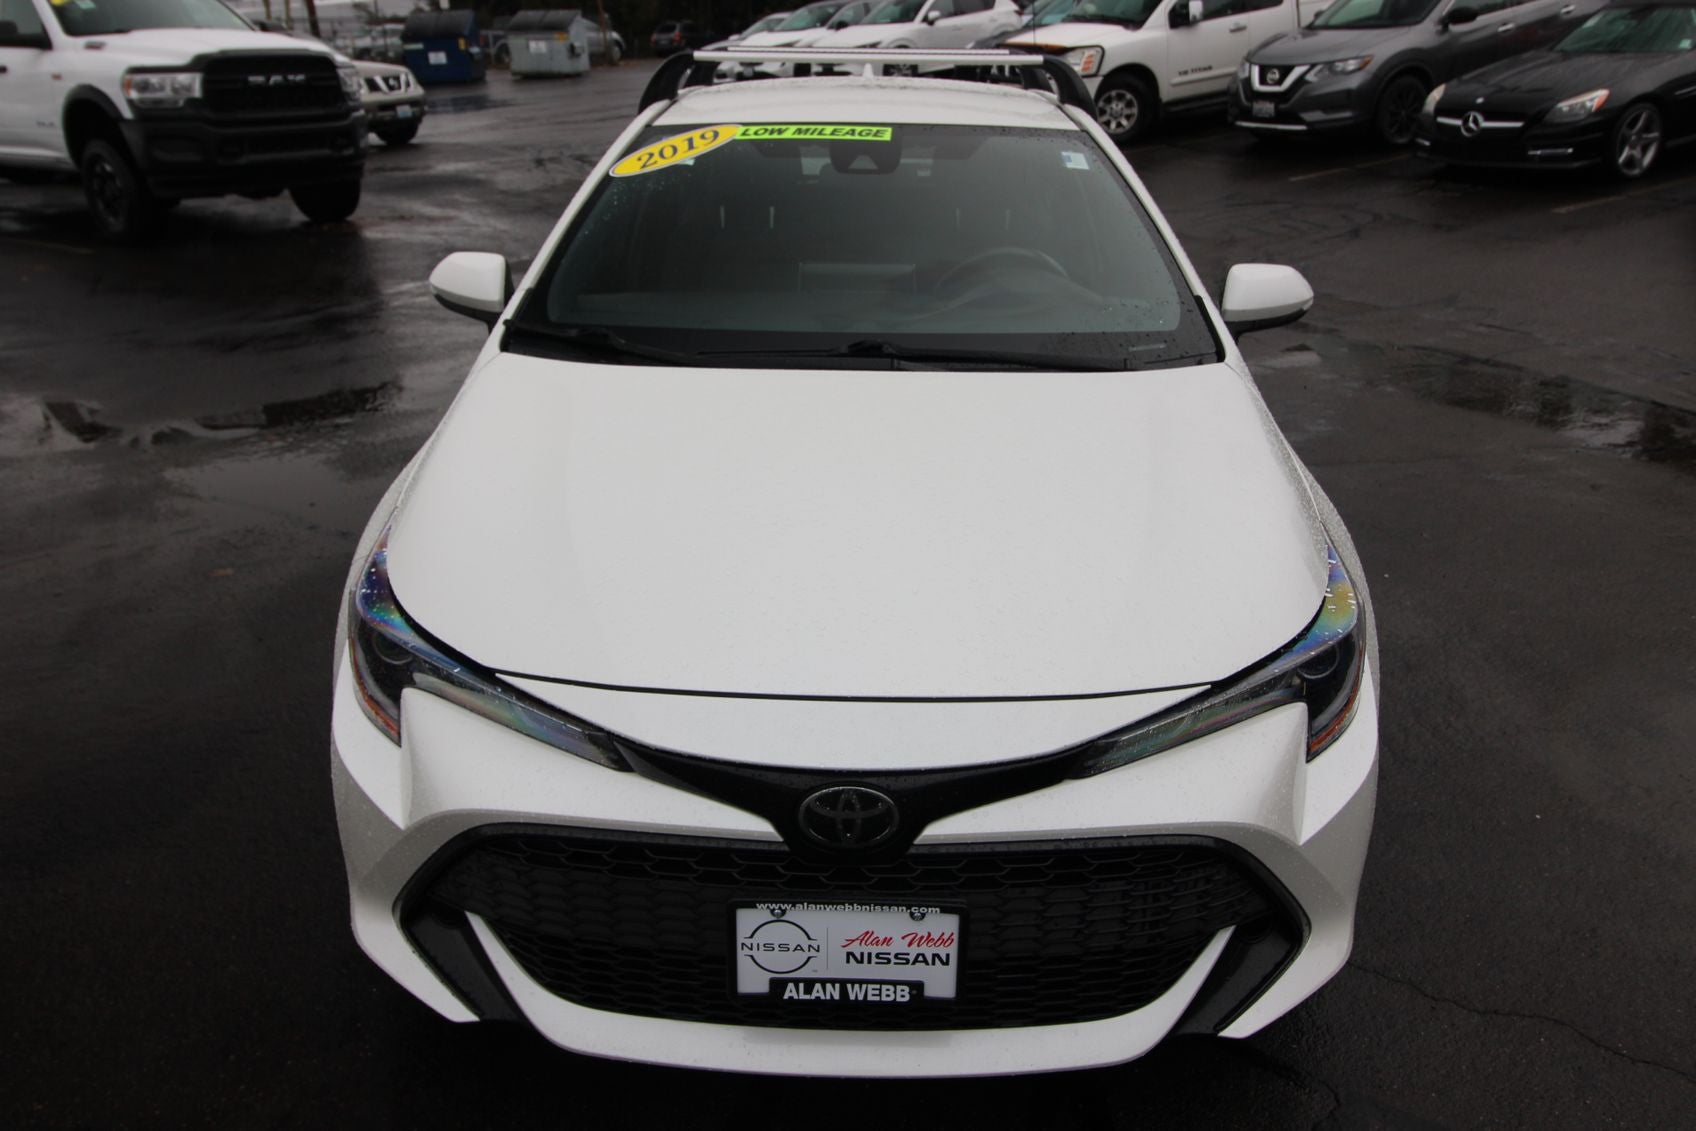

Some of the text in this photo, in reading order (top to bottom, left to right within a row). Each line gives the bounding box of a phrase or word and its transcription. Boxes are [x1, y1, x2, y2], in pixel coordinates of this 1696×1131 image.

[740, 127, 888, 138] LOW MILEAGE
[637, 129, 720, 169] 2019
[756, 902, 941, 914] www.alanwebbnissan.com
[840, 930, 955, 949] Alan Webb
[740, 942, 820, 953] NISSAN
[845, 951, 950, 966] NISSAN
[783, 982, 911, 1002] ALAN WEBB
